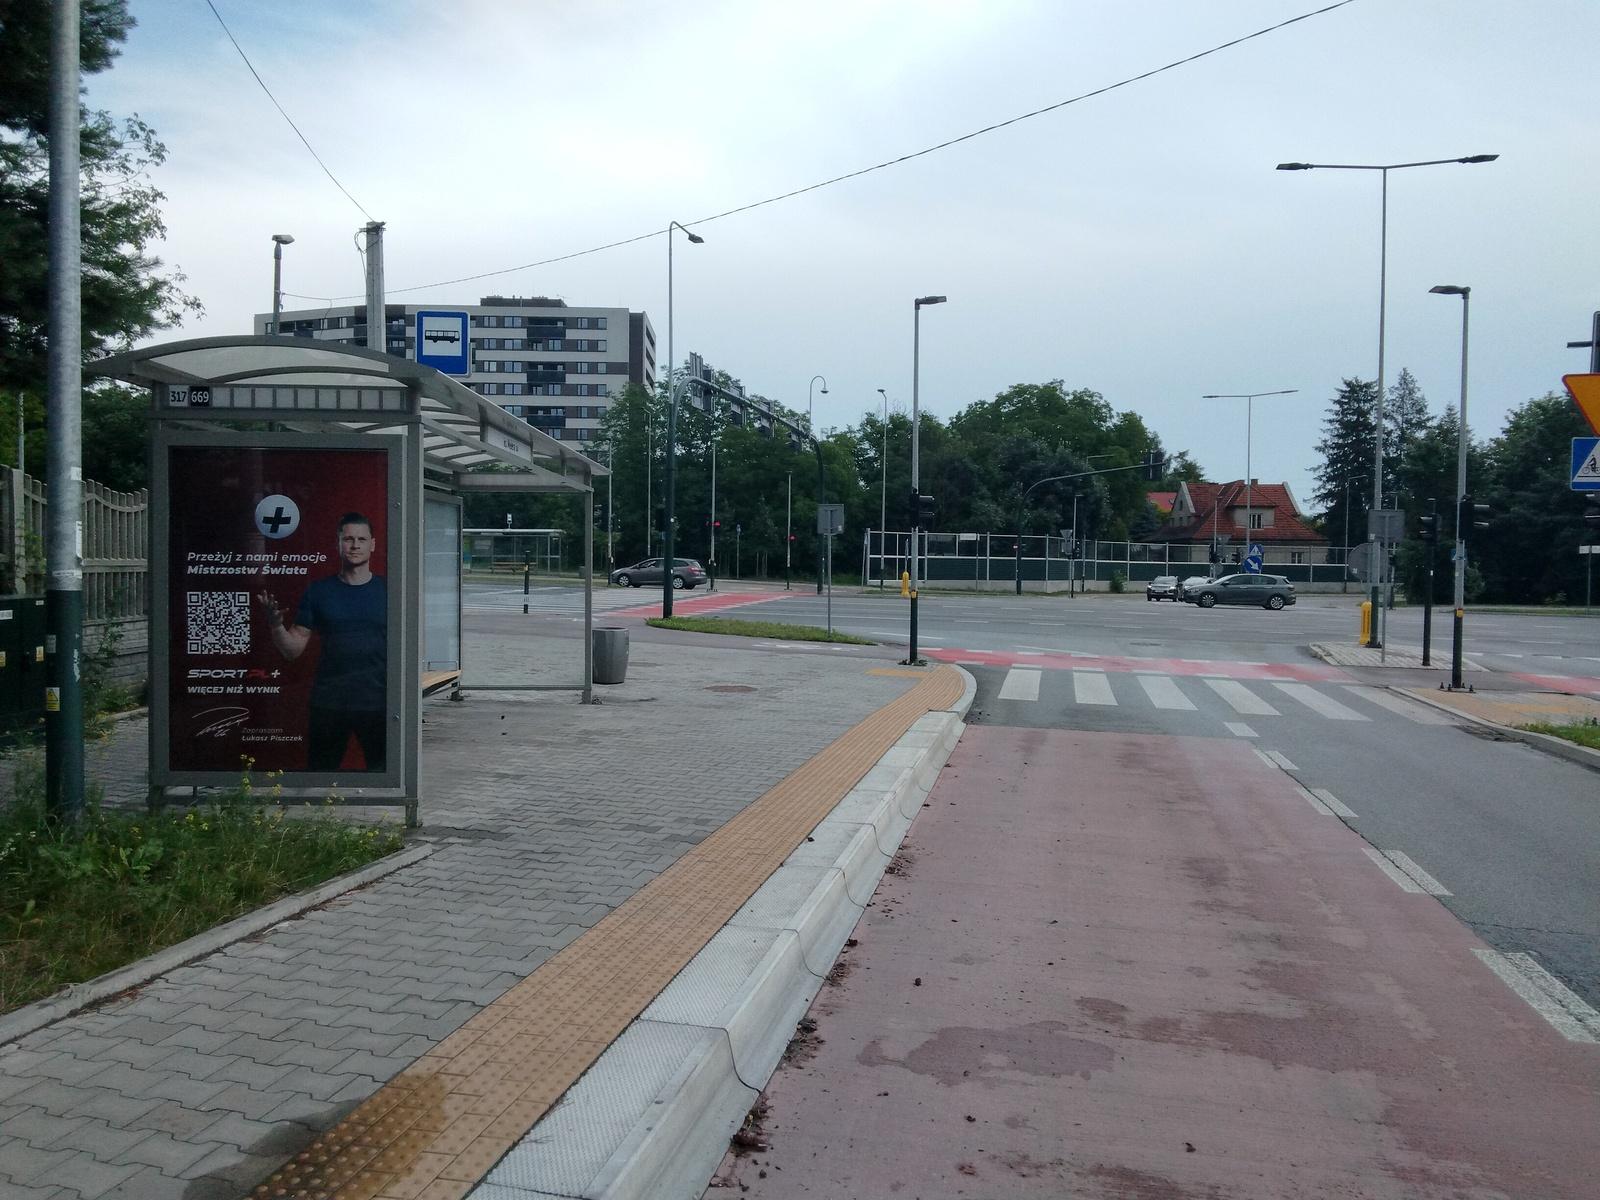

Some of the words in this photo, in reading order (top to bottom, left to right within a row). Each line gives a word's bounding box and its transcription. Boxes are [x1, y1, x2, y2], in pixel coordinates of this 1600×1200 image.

[170, 390, 187, 402] 317
[191, 391, 209, 403] 669
[187, 551, 233, 564] Przeżyj
[235, 553, 243, 561] z
[245, 551, 278, 562] nami
[281, 552, 327, 564] emocje
[187, 564, 259, 575] Mistrzostw
[261, 563, 308, 575] Świata
[187, 686, 224, 695] WIĘCEJ
[226, 684, 243, 694] NIŻ
[246, 686, 281, 694] WYNIK
